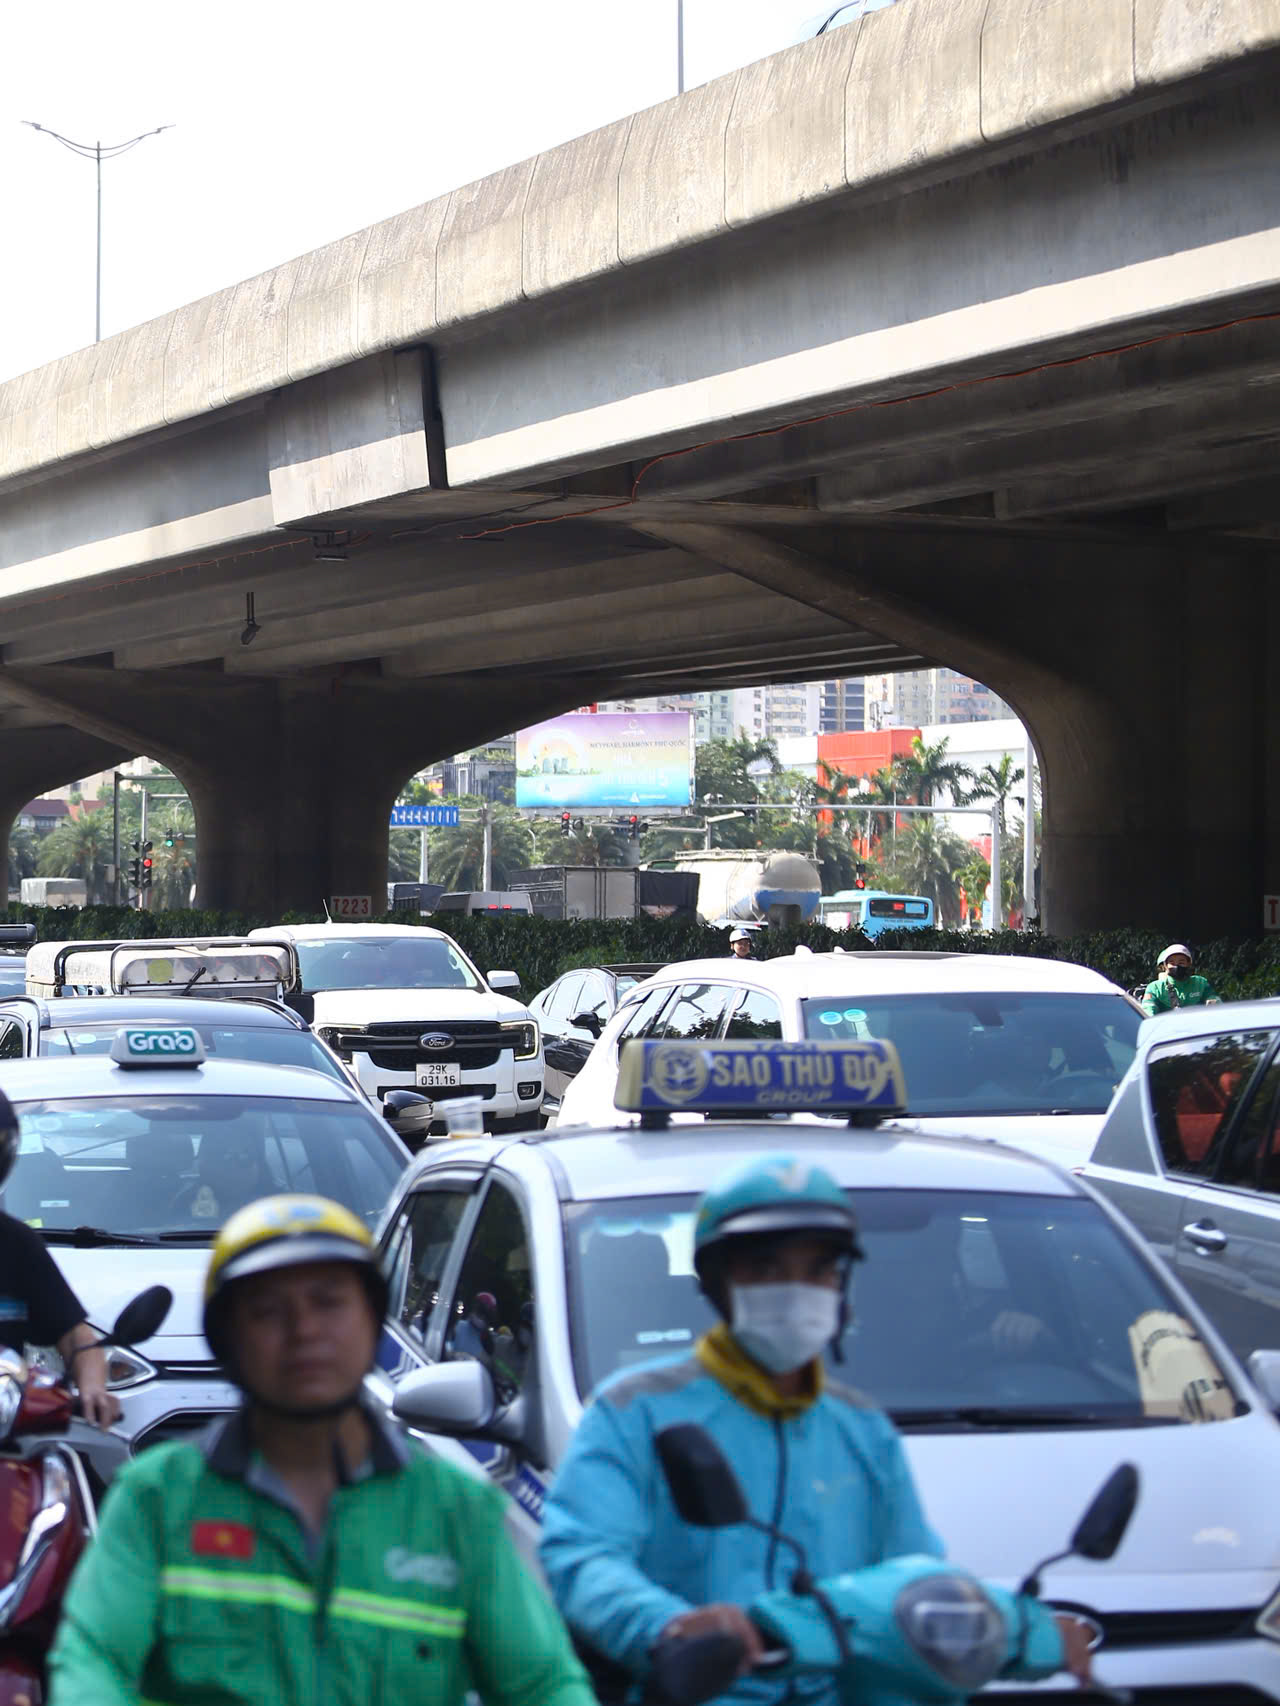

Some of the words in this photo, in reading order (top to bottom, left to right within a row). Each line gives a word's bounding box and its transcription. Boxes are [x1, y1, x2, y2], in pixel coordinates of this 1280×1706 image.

[333, 898, 368, 914] T223
[128, 1031, 195, 1052] Grab
[428, 1037, 447, 1047] Ford
[428, 1065, 448, 1075] 29K
[713, 1055, 771, 1086] SAO
[421, 1075, 456, 1086] 031.16
